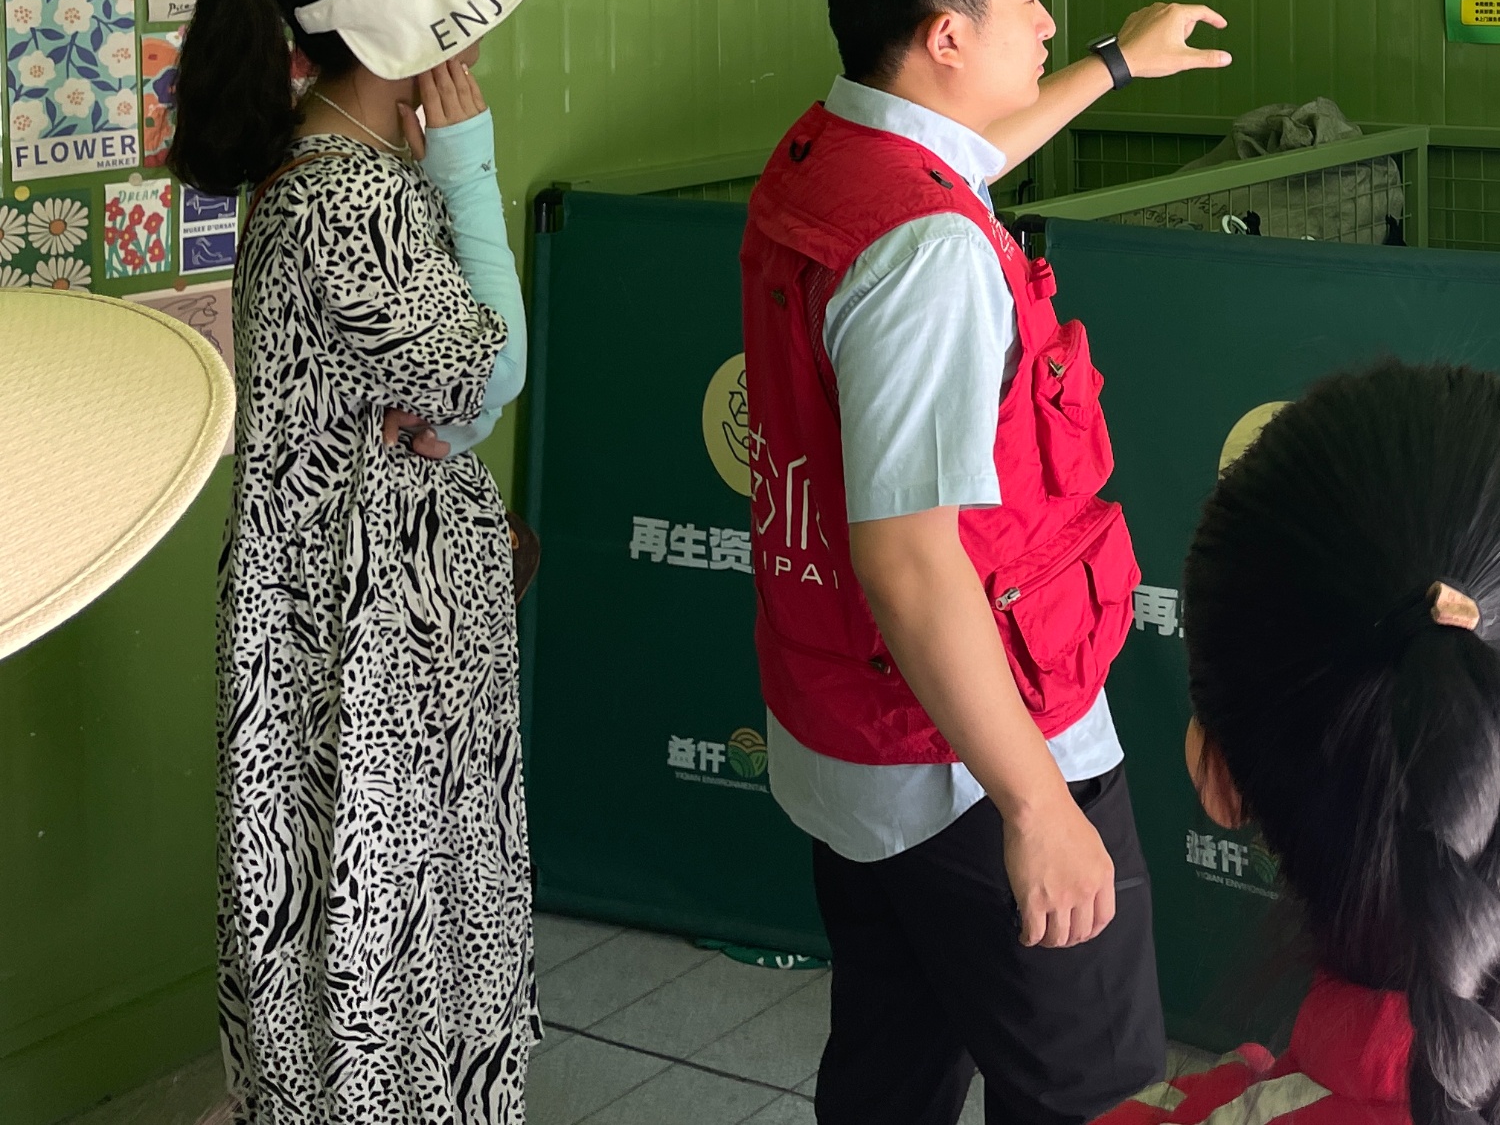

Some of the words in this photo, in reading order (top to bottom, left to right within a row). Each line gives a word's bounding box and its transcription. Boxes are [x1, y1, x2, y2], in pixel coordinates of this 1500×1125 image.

[16, 135, 136, 167] FLOWER
[97, 157, 136, 168] MARKET
[118, 189, 159, 203] DREAM
